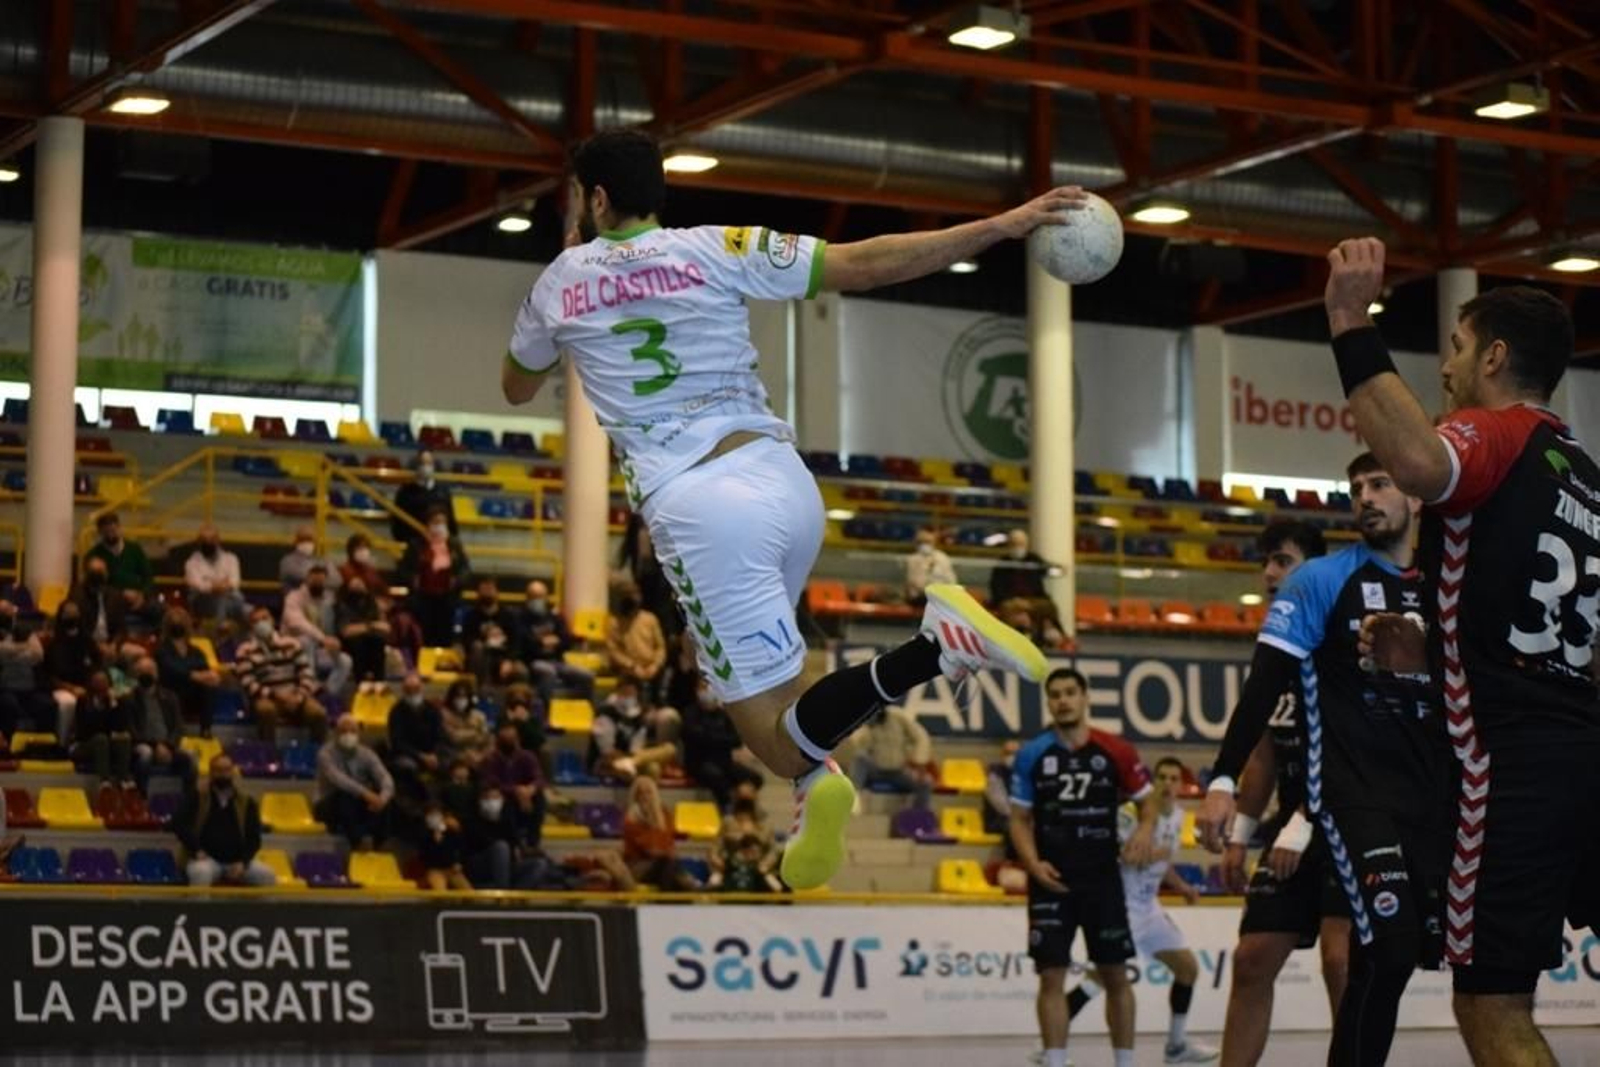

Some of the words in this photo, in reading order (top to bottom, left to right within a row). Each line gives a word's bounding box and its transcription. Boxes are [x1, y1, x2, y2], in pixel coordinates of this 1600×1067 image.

[206, 276, 290, 300] GRATIS
[562, 281, 597, 319] DEL
[598, 263, 706, 308] CASTILLO
[611, 318, 682, 396] 3
[1059, 773, 1092, 800] 27
[31, 915, 351, 968] DESCÁRGATE
[481, 938, 562, 994] TV
[666, 937, 881, 998] sacyr
[13, 981, 74, 1022] LA
[93, 981, 187, 1022] APP
[205, 981, 374, 1023] GRATIS
